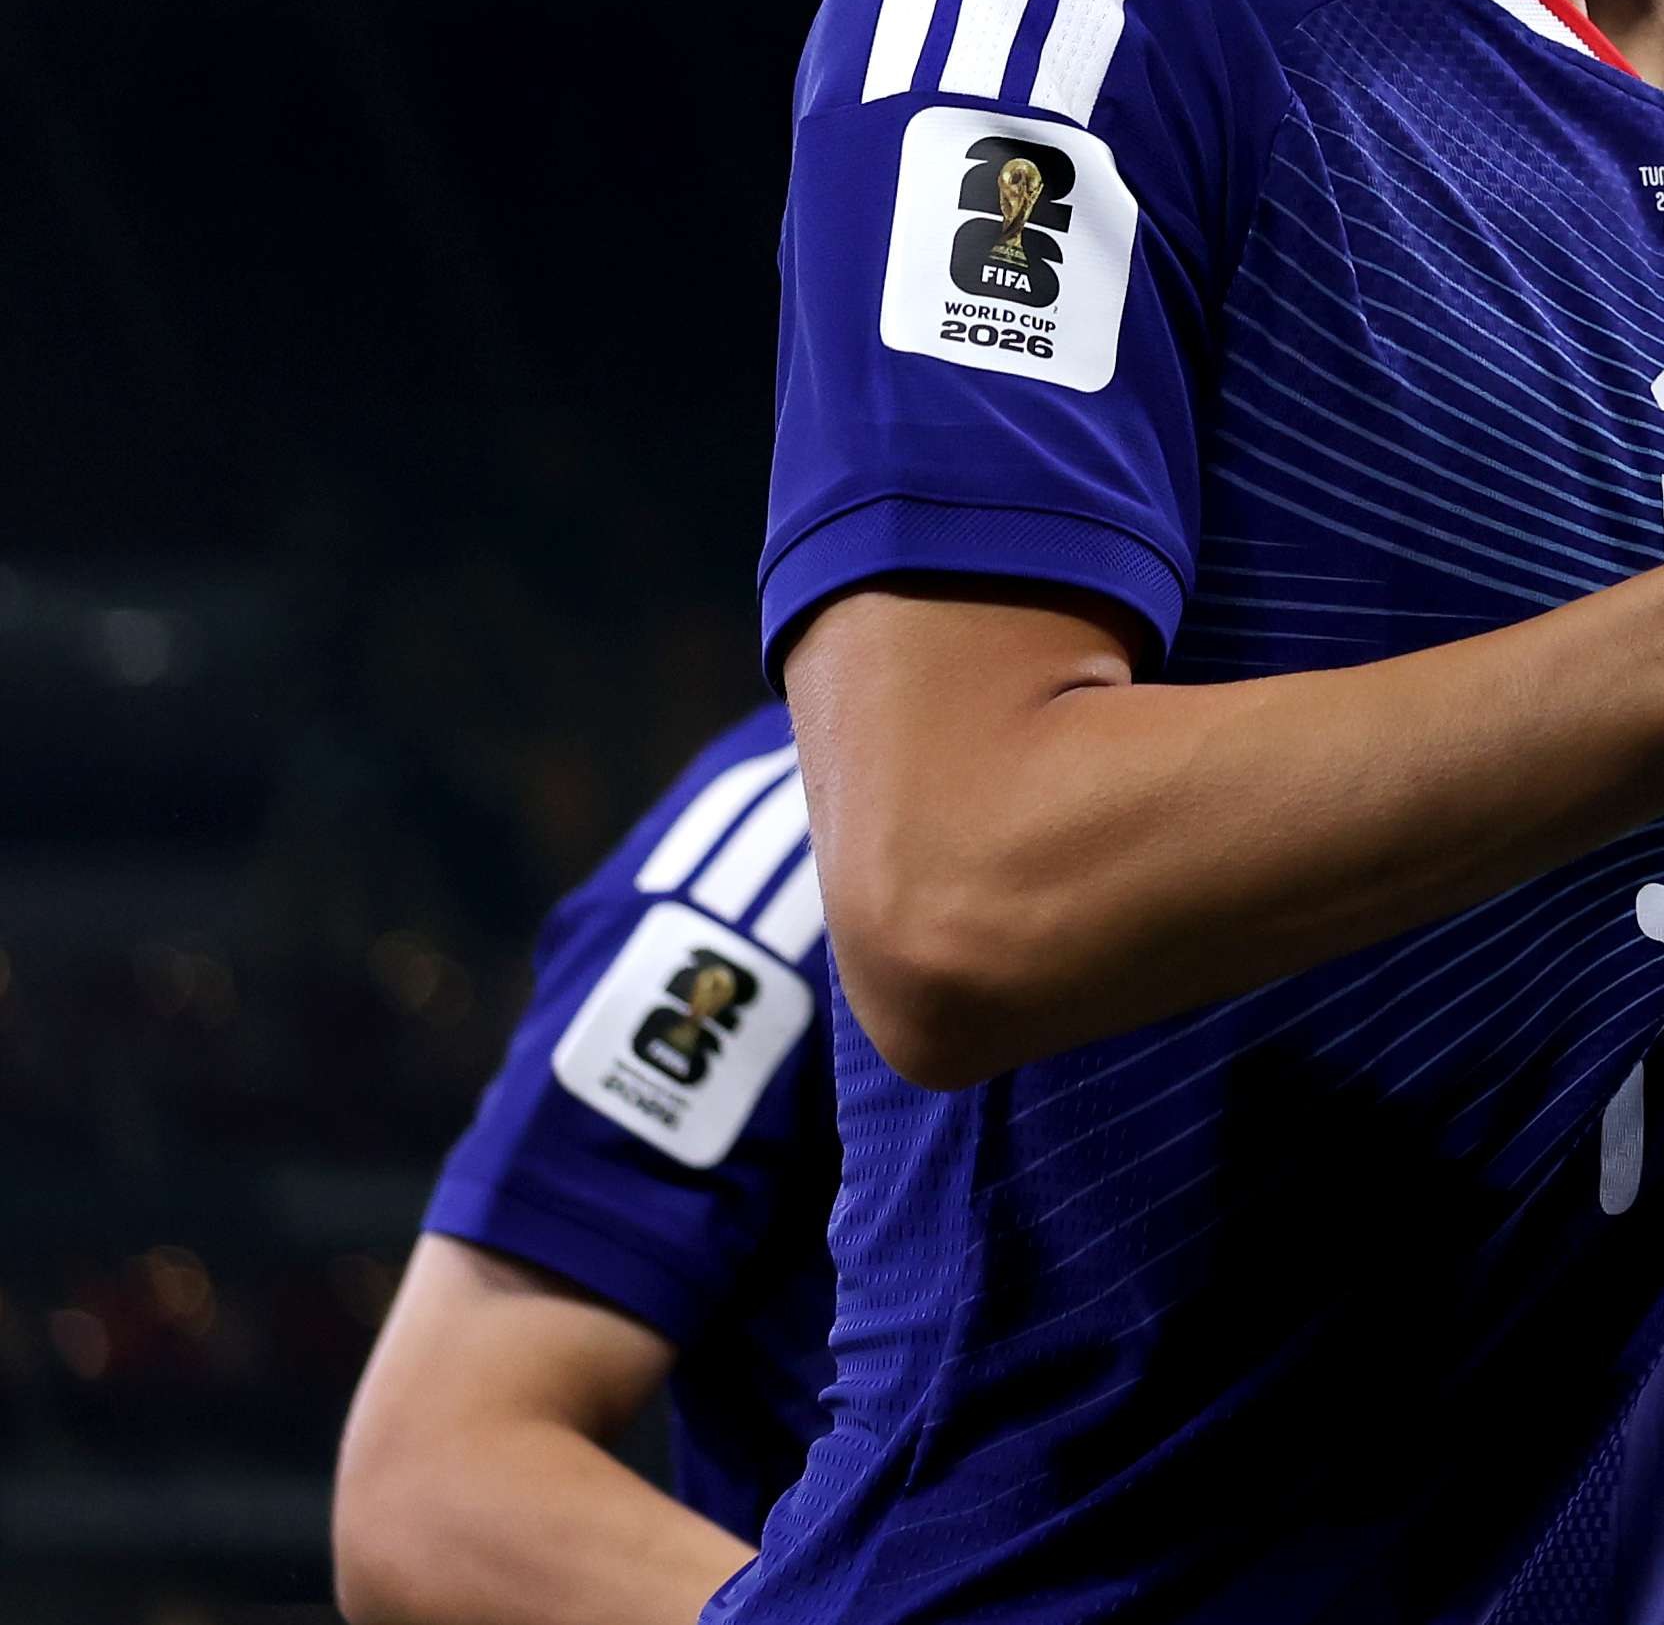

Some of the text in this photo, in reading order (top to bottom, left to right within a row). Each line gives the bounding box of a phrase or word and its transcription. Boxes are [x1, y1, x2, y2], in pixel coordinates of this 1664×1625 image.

[981, 265, 1032, 293] FIFA
[944, 301, 1057, 334] WORLD CUP
[939, 320, 1055, 359] 2026
